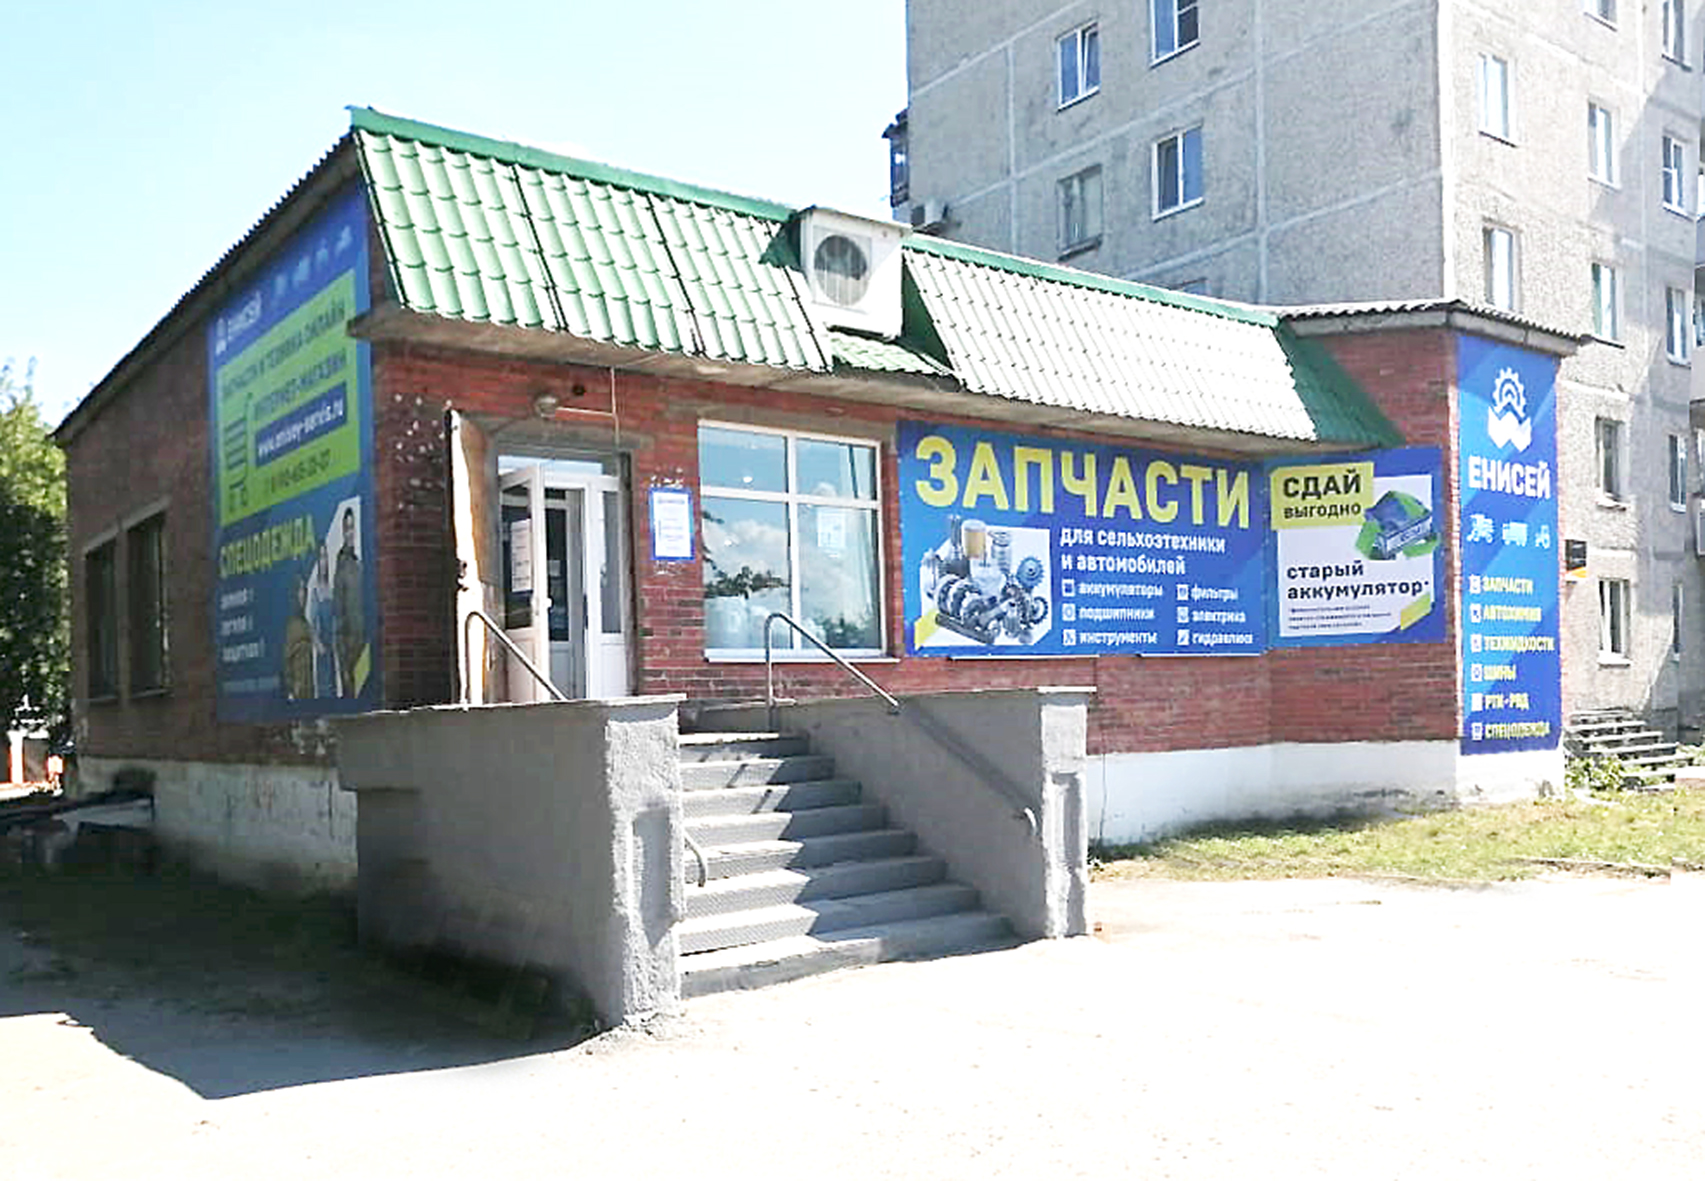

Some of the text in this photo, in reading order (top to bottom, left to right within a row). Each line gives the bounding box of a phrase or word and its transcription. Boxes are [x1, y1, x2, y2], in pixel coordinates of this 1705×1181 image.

[915, 435, 1250, 530] ЗАПЧАСТИ
[1283, 468, 1361, 500] СДАЙ
[1468, 454, 1551, 499] ЕНИСЕЙ
[1284, 503, 1362, 519] выгодно
[1060, 527, 1226, 553] для сельхозтехники
[1061, 553, 1186, 575] и автомобилей
[1287, 560, 1364, 581] старый
[1078, 582, 1164, 599] аккумуляторы
[1190, 584, 1239, 601] фильтры
[1483, 576, 1534, 594] ЗАПЧАСТИ
[1078, 606, 1155, 622] подшипники
[1079, 631, 1158, 646] инструменты
[1483, 664, 1517, 681] ШИНЫ
